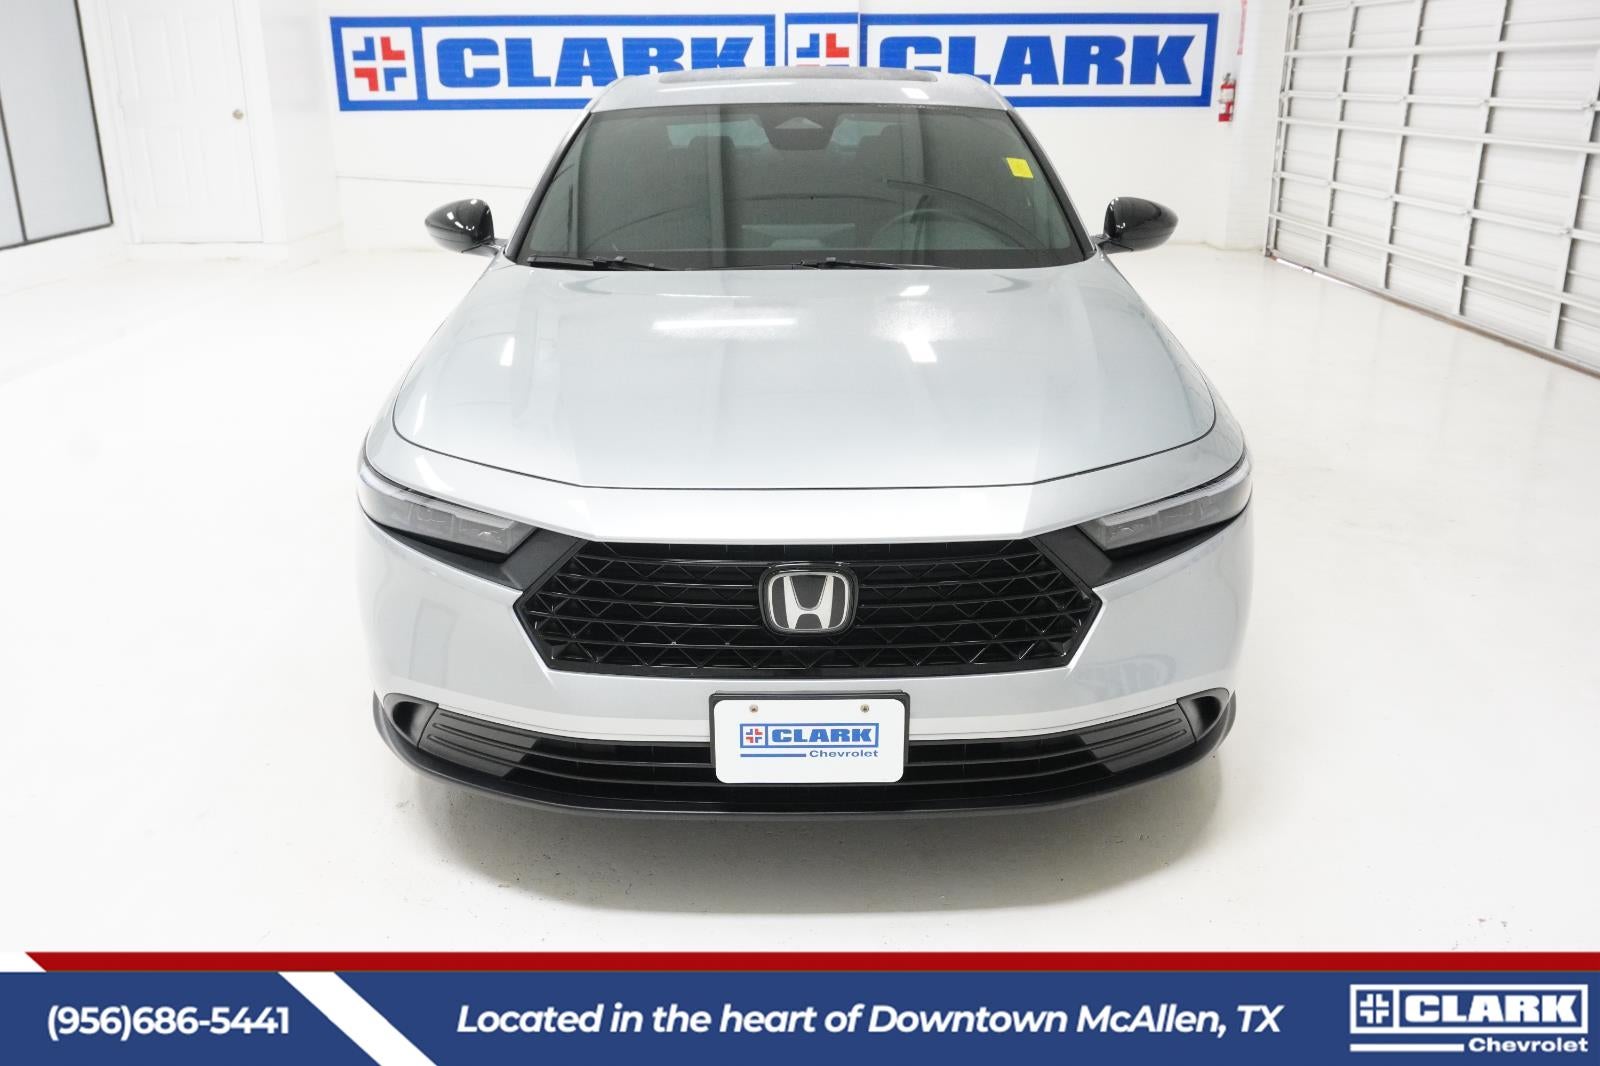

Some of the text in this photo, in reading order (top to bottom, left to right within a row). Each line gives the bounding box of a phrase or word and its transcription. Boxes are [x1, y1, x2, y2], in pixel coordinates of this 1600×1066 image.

[436, 36, 753, 88] CLARK
[879, 35, 1194, 86] CLARK
[771, 728, 872, 743] CLARK
[809, 749, 879, 758] Chevrolet
